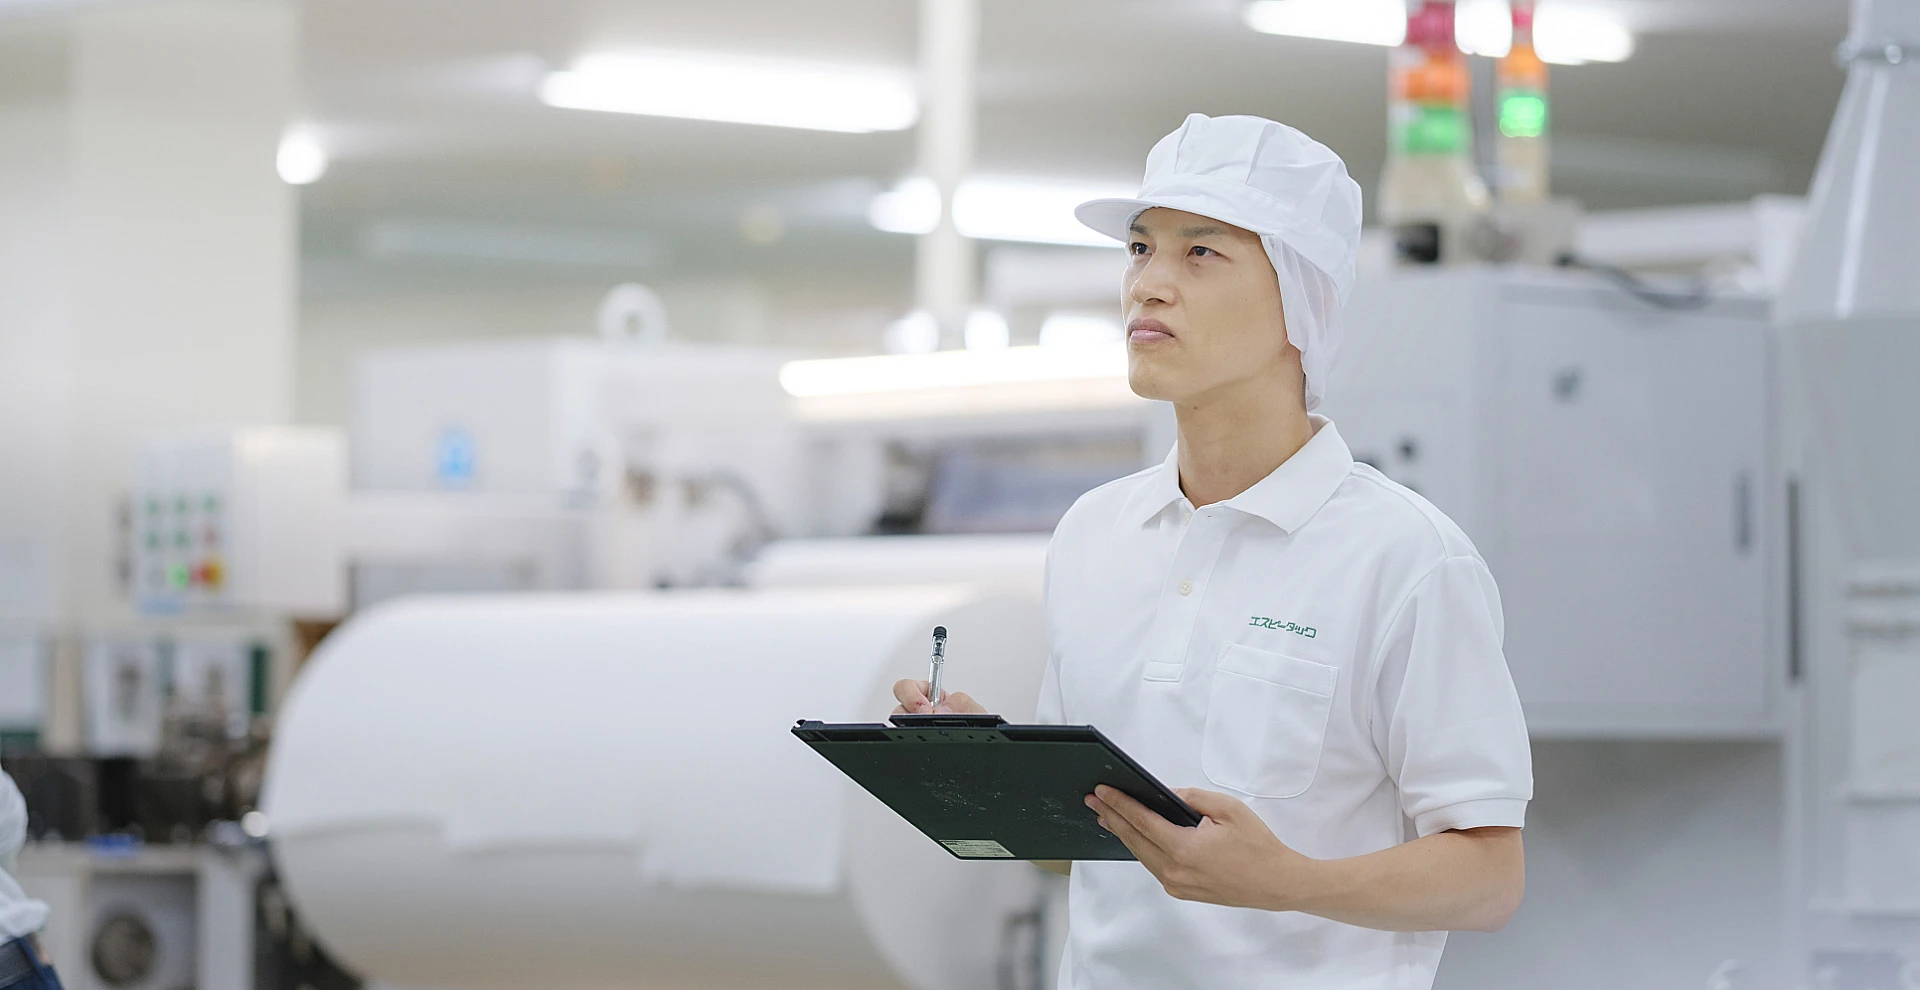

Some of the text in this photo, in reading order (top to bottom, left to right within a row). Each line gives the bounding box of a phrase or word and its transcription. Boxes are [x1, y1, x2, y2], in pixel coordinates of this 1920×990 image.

[1249, 616, 1317, 639] エスピータック
